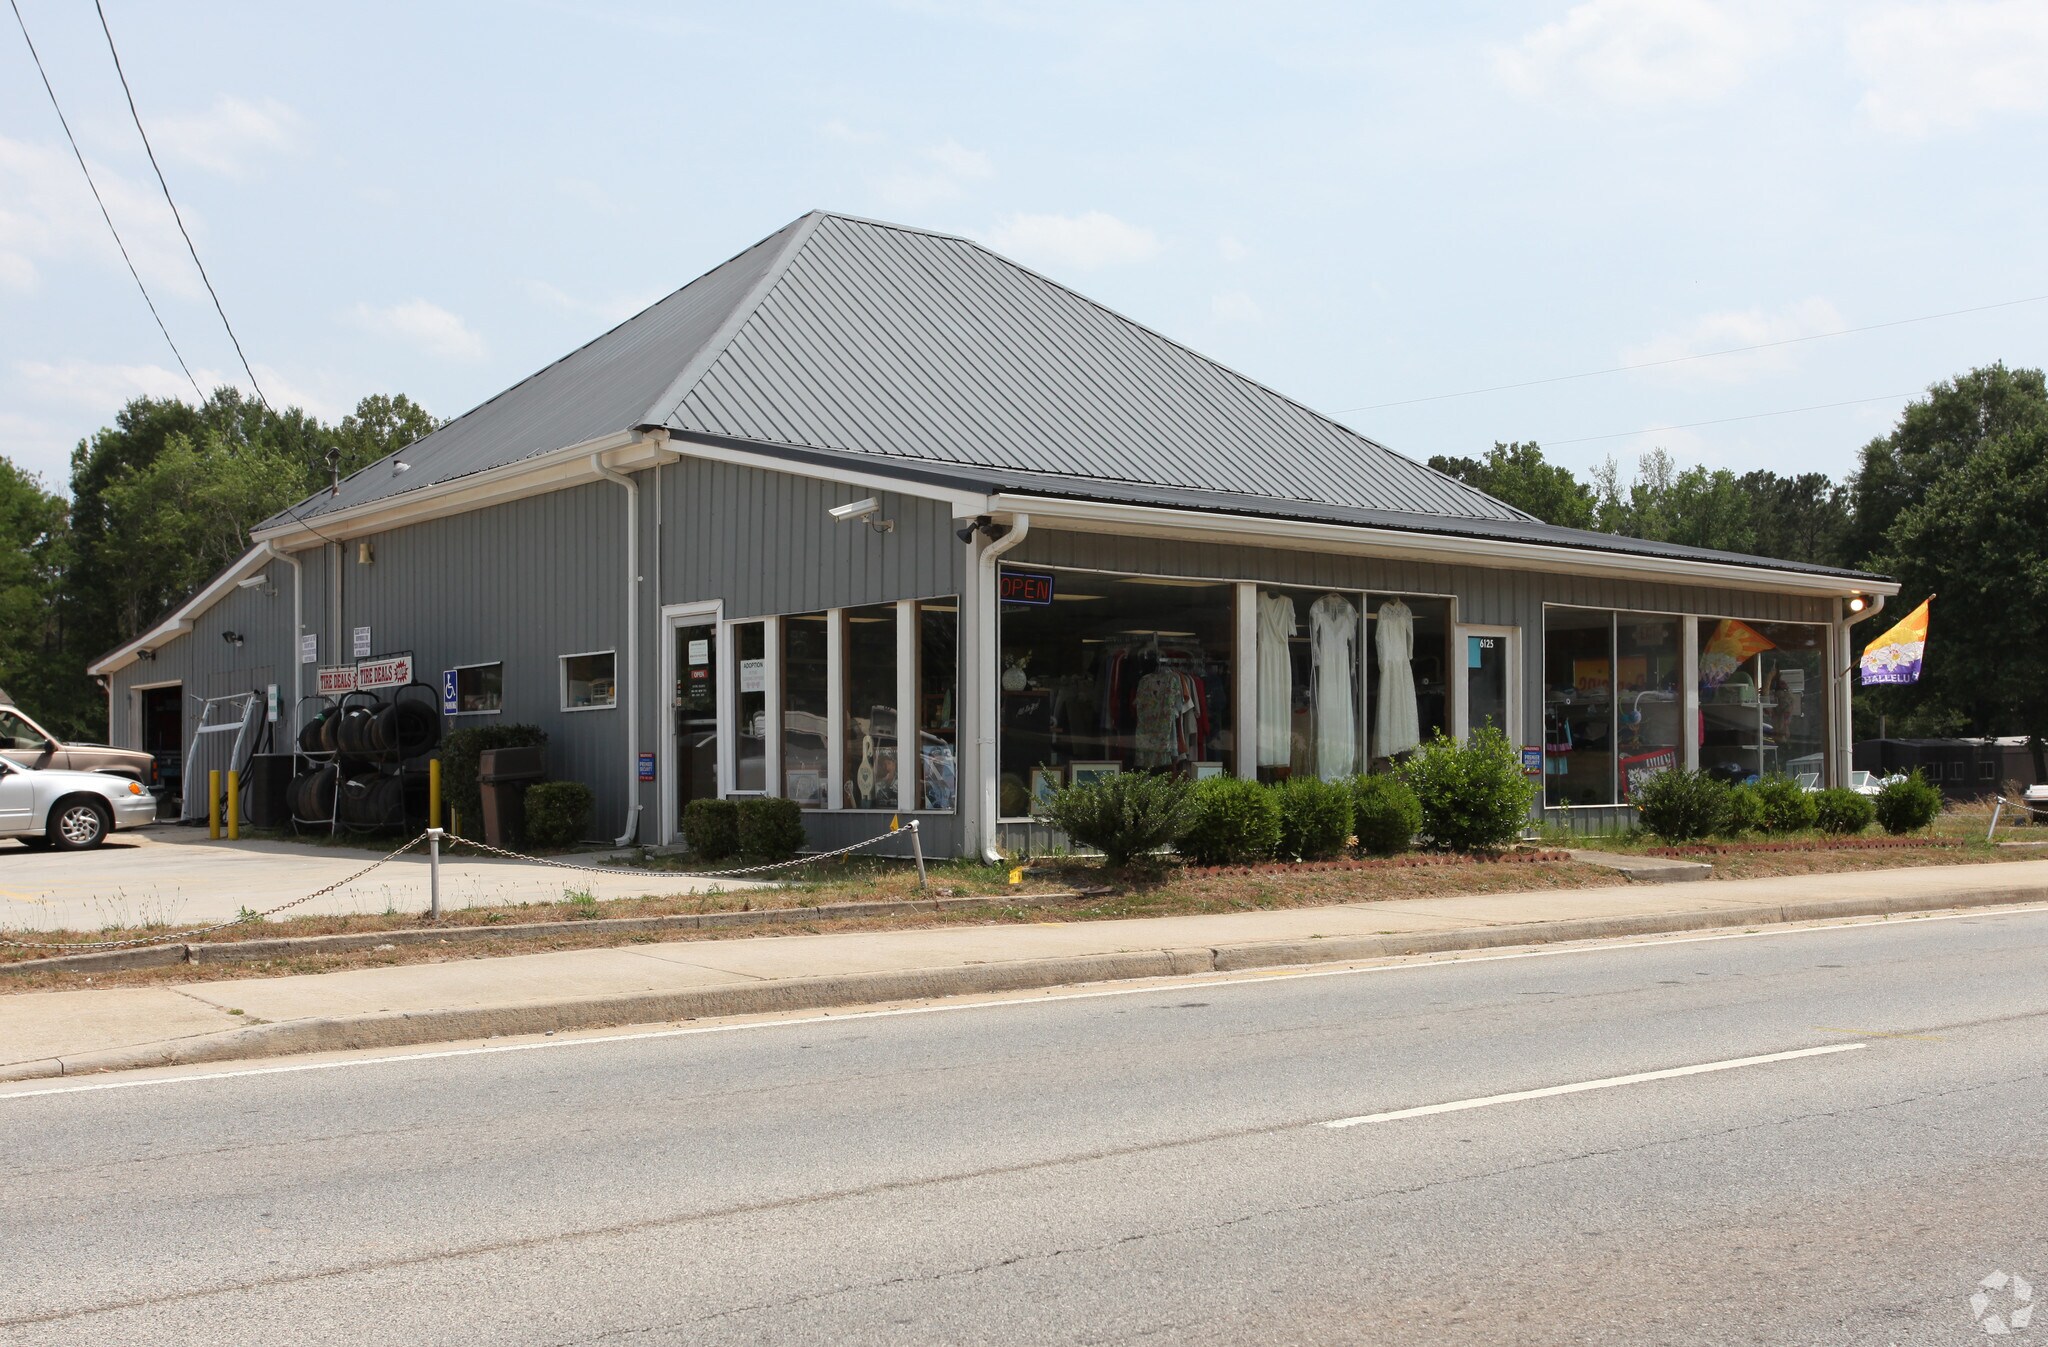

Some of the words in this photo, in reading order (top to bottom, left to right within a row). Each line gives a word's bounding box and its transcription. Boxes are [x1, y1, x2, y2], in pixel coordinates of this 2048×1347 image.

[1000, 577, 1049, 600] OPEN
[1479, 639, 1494, 648] 6125
[320, 675, 332, 689] TIRE
[333, 673, 352, 689] DEALS
[360, 667, 373, 685] TIRE
[374, 665, 393, 683] DEALS
[693, 671, 705, 679] OPEN
[1862, 672, 1920, 685] HALLELU
